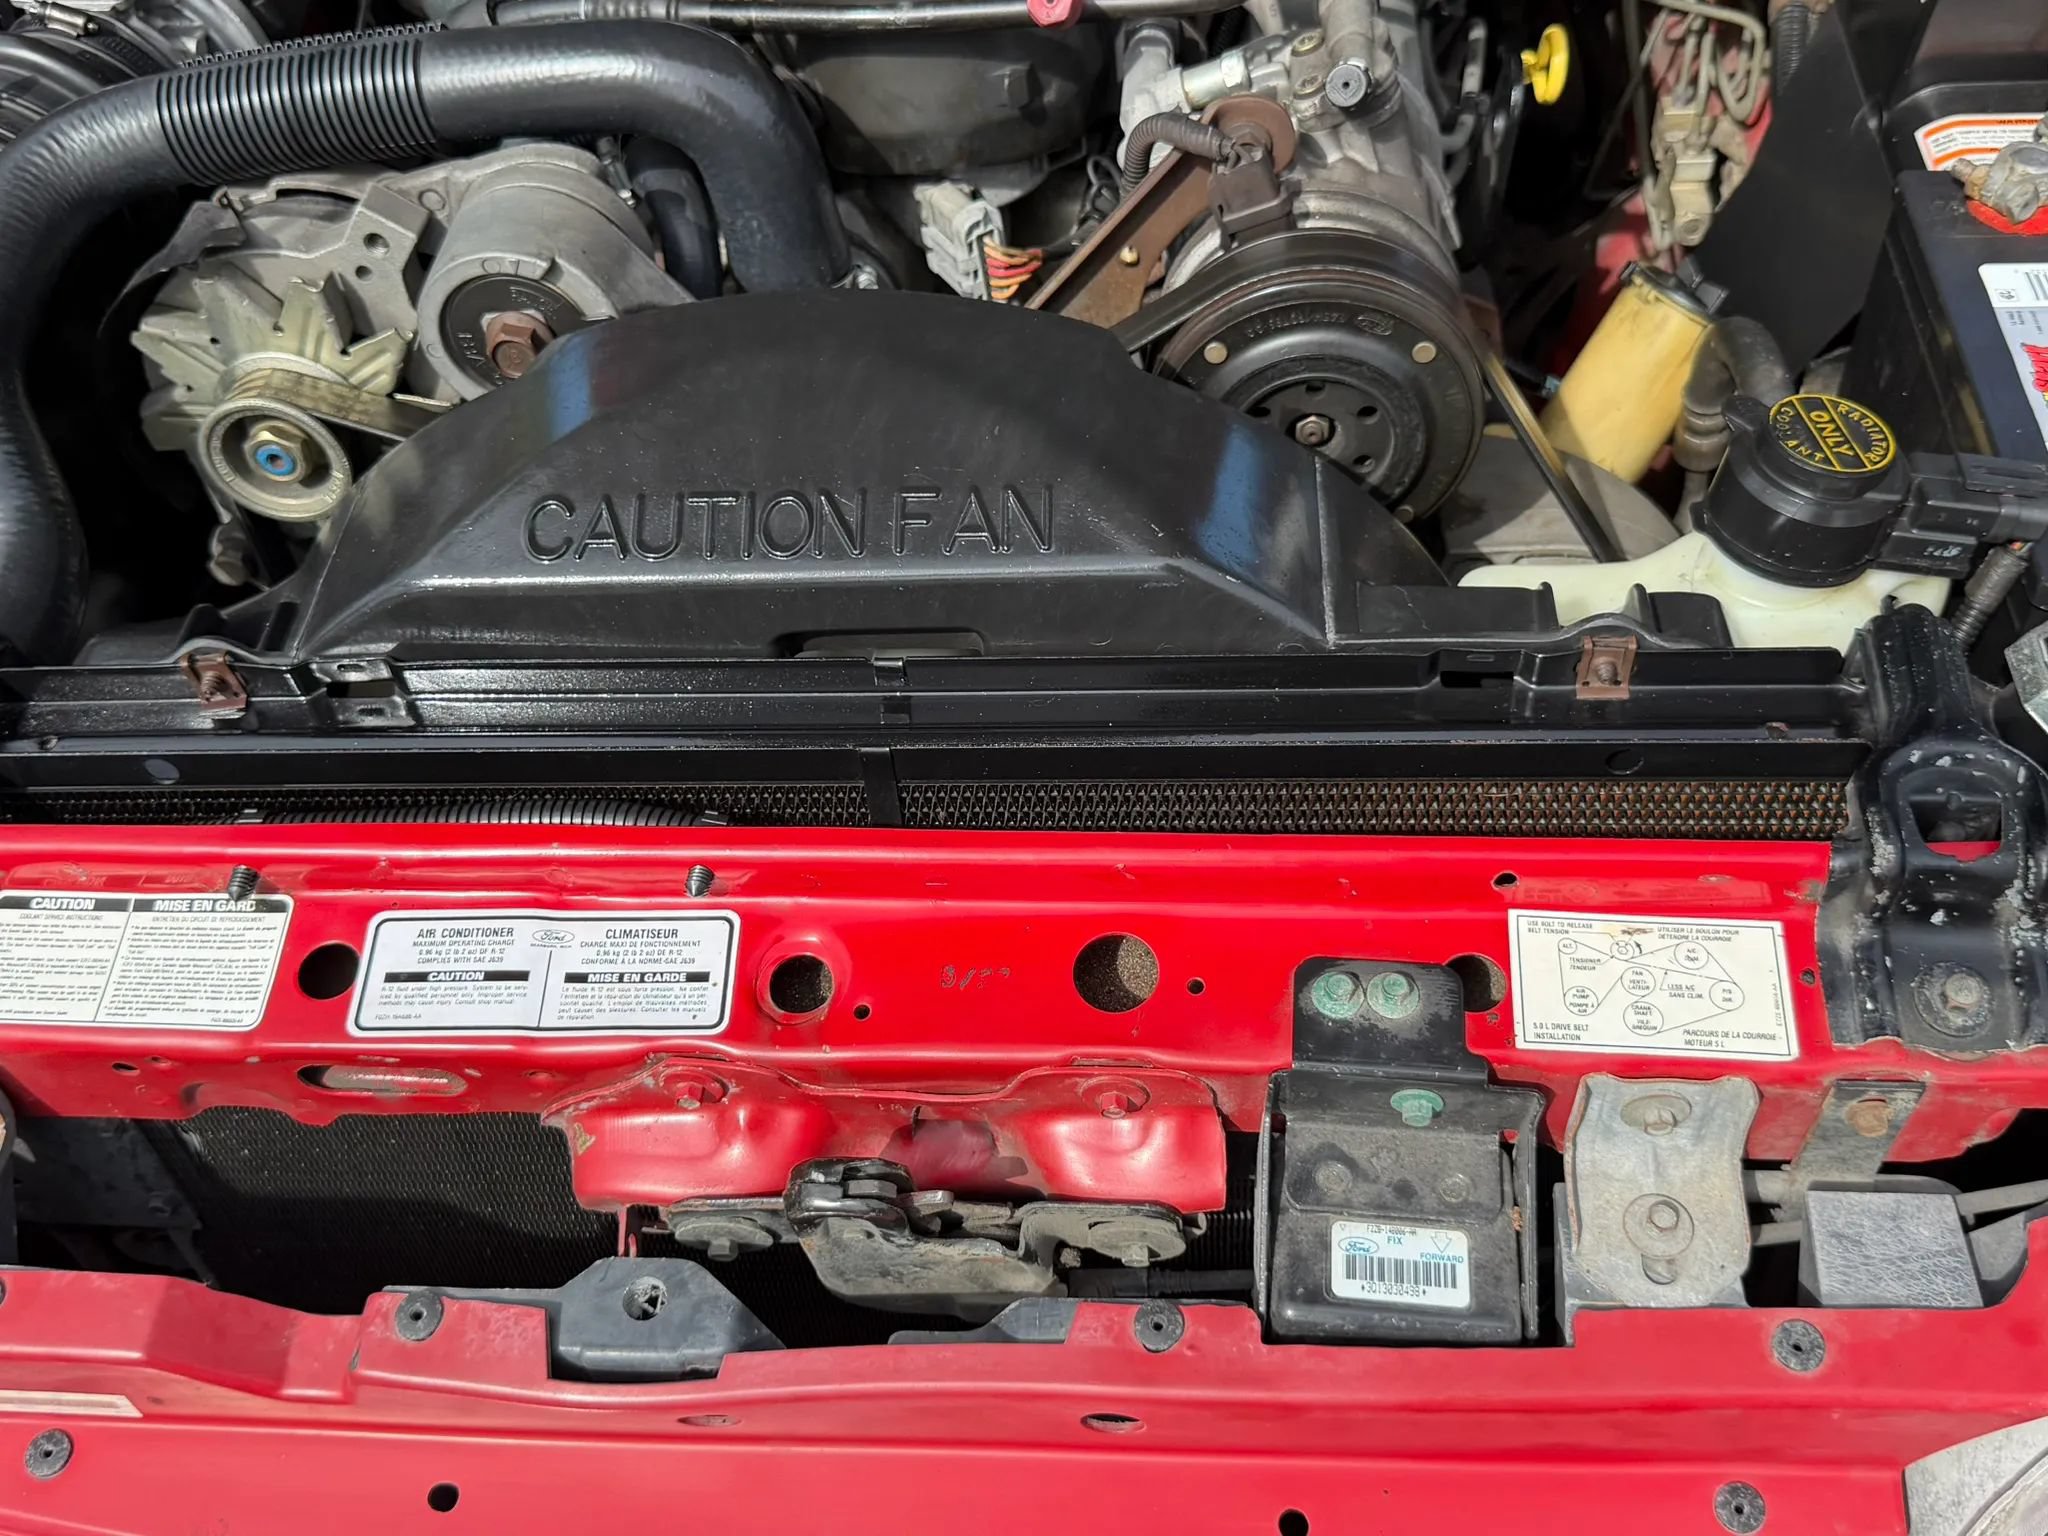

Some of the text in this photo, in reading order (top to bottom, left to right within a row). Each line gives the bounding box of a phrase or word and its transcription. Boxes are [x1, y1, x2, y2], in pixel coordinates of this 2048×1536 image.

[1809, 410, 1855, 457] ONLY
[1838, 403, 1889, 463] RADIATOR
[523, 483, 1056, 564] CAUTION FAN
[30, 898, 96, 910] CAUTION
[153, 900, 257, 912] MISE EN GARD
[417, 927, 514, 938] AIR CONDITIONER
[541, 930, 567, 942] Ford
[606, 928, 678, 939] CLIMATISEUR
[427, 972, 485, 981] CAUTION
[587, 973, 687, 982] MISE EN GARDE
[1534, 1032, 1581, 1040] INSTALLATION
[1683, 1029, 1719, 1037] PARCOURS
[1721, 1030, 1730, 1038] DE
[1742, 1031, 1776, 1040] COURROIE
[1684, 1039, 1713, 1047] MOTEUR
[1387, 1236, 1403, 1245] FIX
[1345, 1241, 1371, 1253] Ford
[1420, 1252, 1464, 1263] FORWARD
